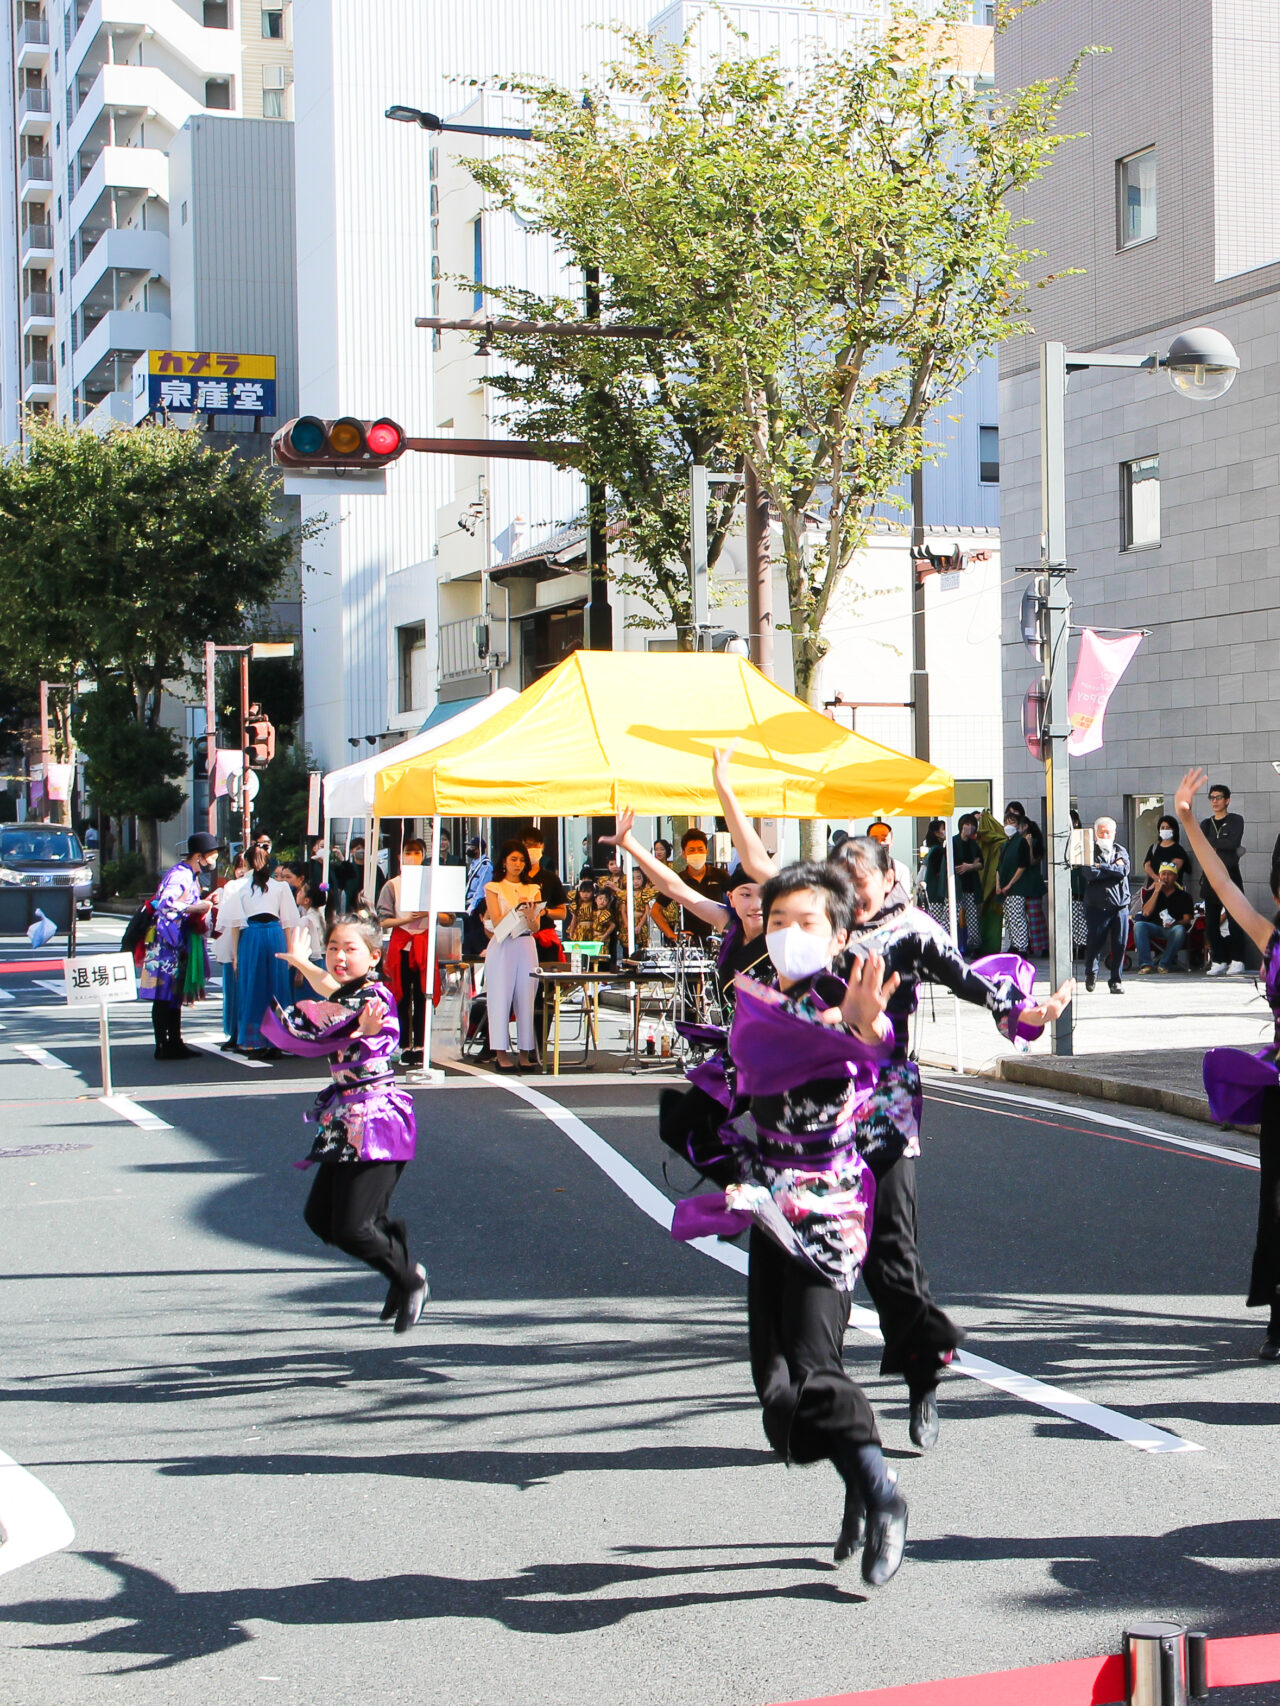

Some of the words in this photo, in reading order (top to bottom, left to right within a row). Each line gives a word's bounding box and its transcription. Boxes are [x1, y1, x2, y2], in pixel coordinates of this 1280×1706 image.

[158, 353, 240, 375] カメラ
[160, 380, 264, 410] 泉崖堂
[72, 966, 127, 988] 退場口
